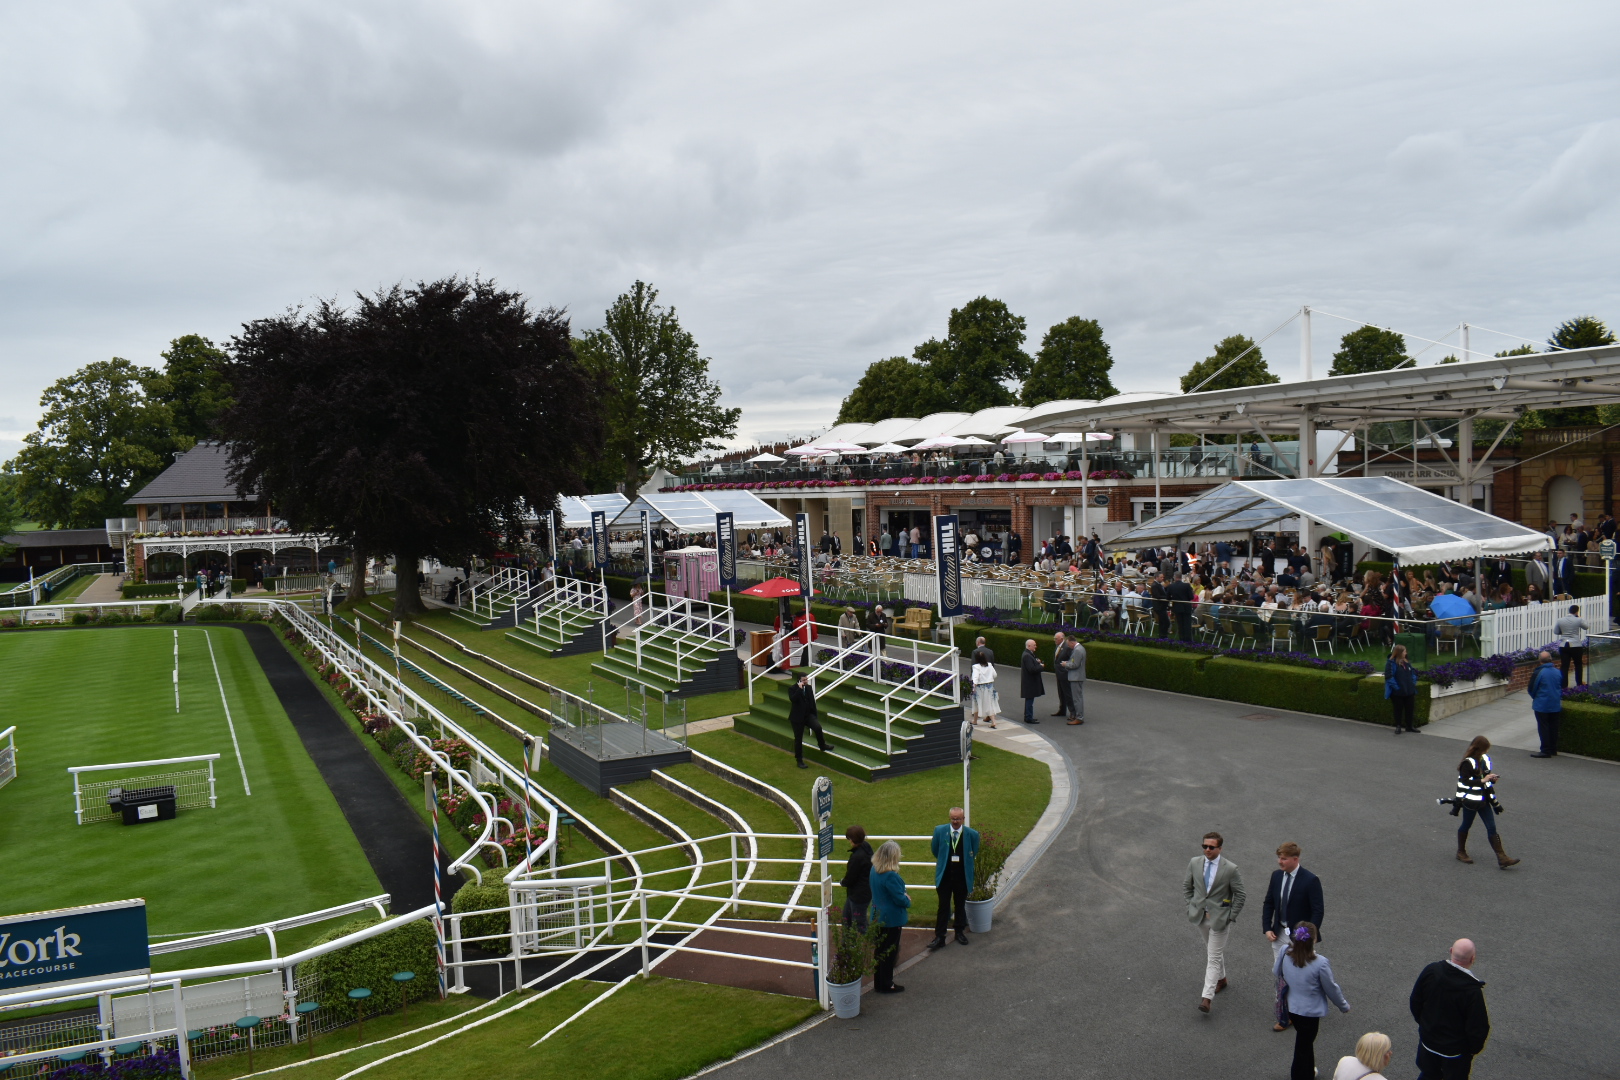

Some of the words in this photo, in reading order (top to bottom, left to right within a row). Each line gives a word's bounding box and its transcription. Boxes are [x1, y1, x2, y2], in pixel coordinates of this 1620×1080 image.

[1385, 470, 1406, 479] JOHN
[1408, 470, 1432, 478] CARR
[719, 516, 731, 540] HILL
[797, 519, 805, 545] HILL
[940, 522, 955, 554] HILL
[943, 553, 960, 610] William
[818, 792, 831, 807] York
